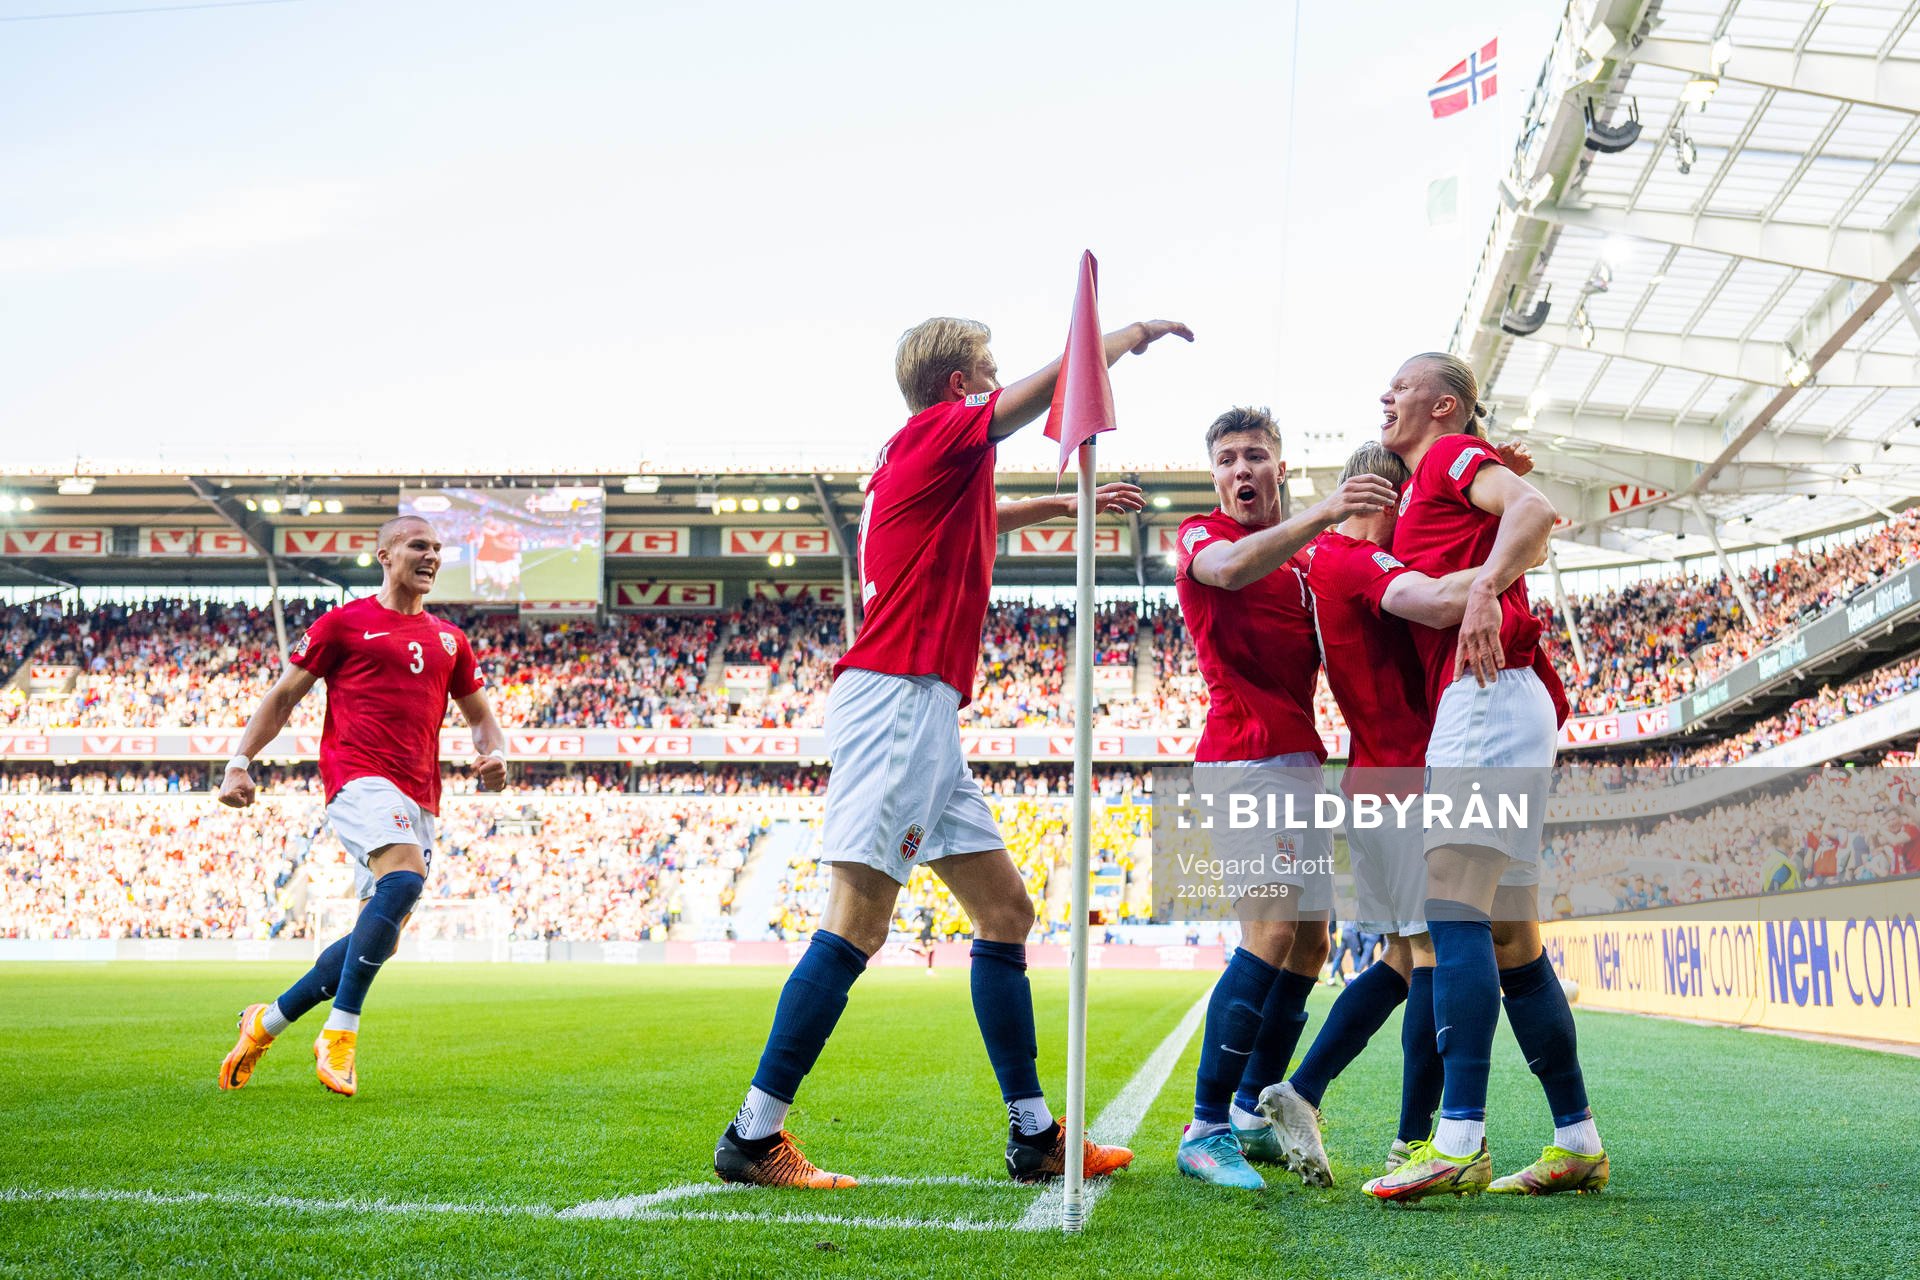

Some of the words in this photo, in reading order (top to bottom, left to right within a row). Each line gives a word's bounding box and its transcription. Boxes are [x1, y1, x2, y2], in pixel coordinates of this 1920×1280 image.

[8, 532, 97, 553] VG
[153, 532, 242, 553] VG
[289, 532, 378, 553] VG
[734, 532, 824, 552] VG
[1023, 530, 1114, 551] VG
[621, 584, 711, 605] VG
[758, 584, 844, 604] VG
[408, 641, 425, 674] 3
[1568, 719, 1618, 742] VG
[1638, 710, 1669, 734] VG
[84, 737, 154, 753] VG
[512, 737, 582, 753] VG
[620, 737, 690, 753] VG
[727, 737, 797, 753] VG
[1050, 737, 1121, 753] VG
